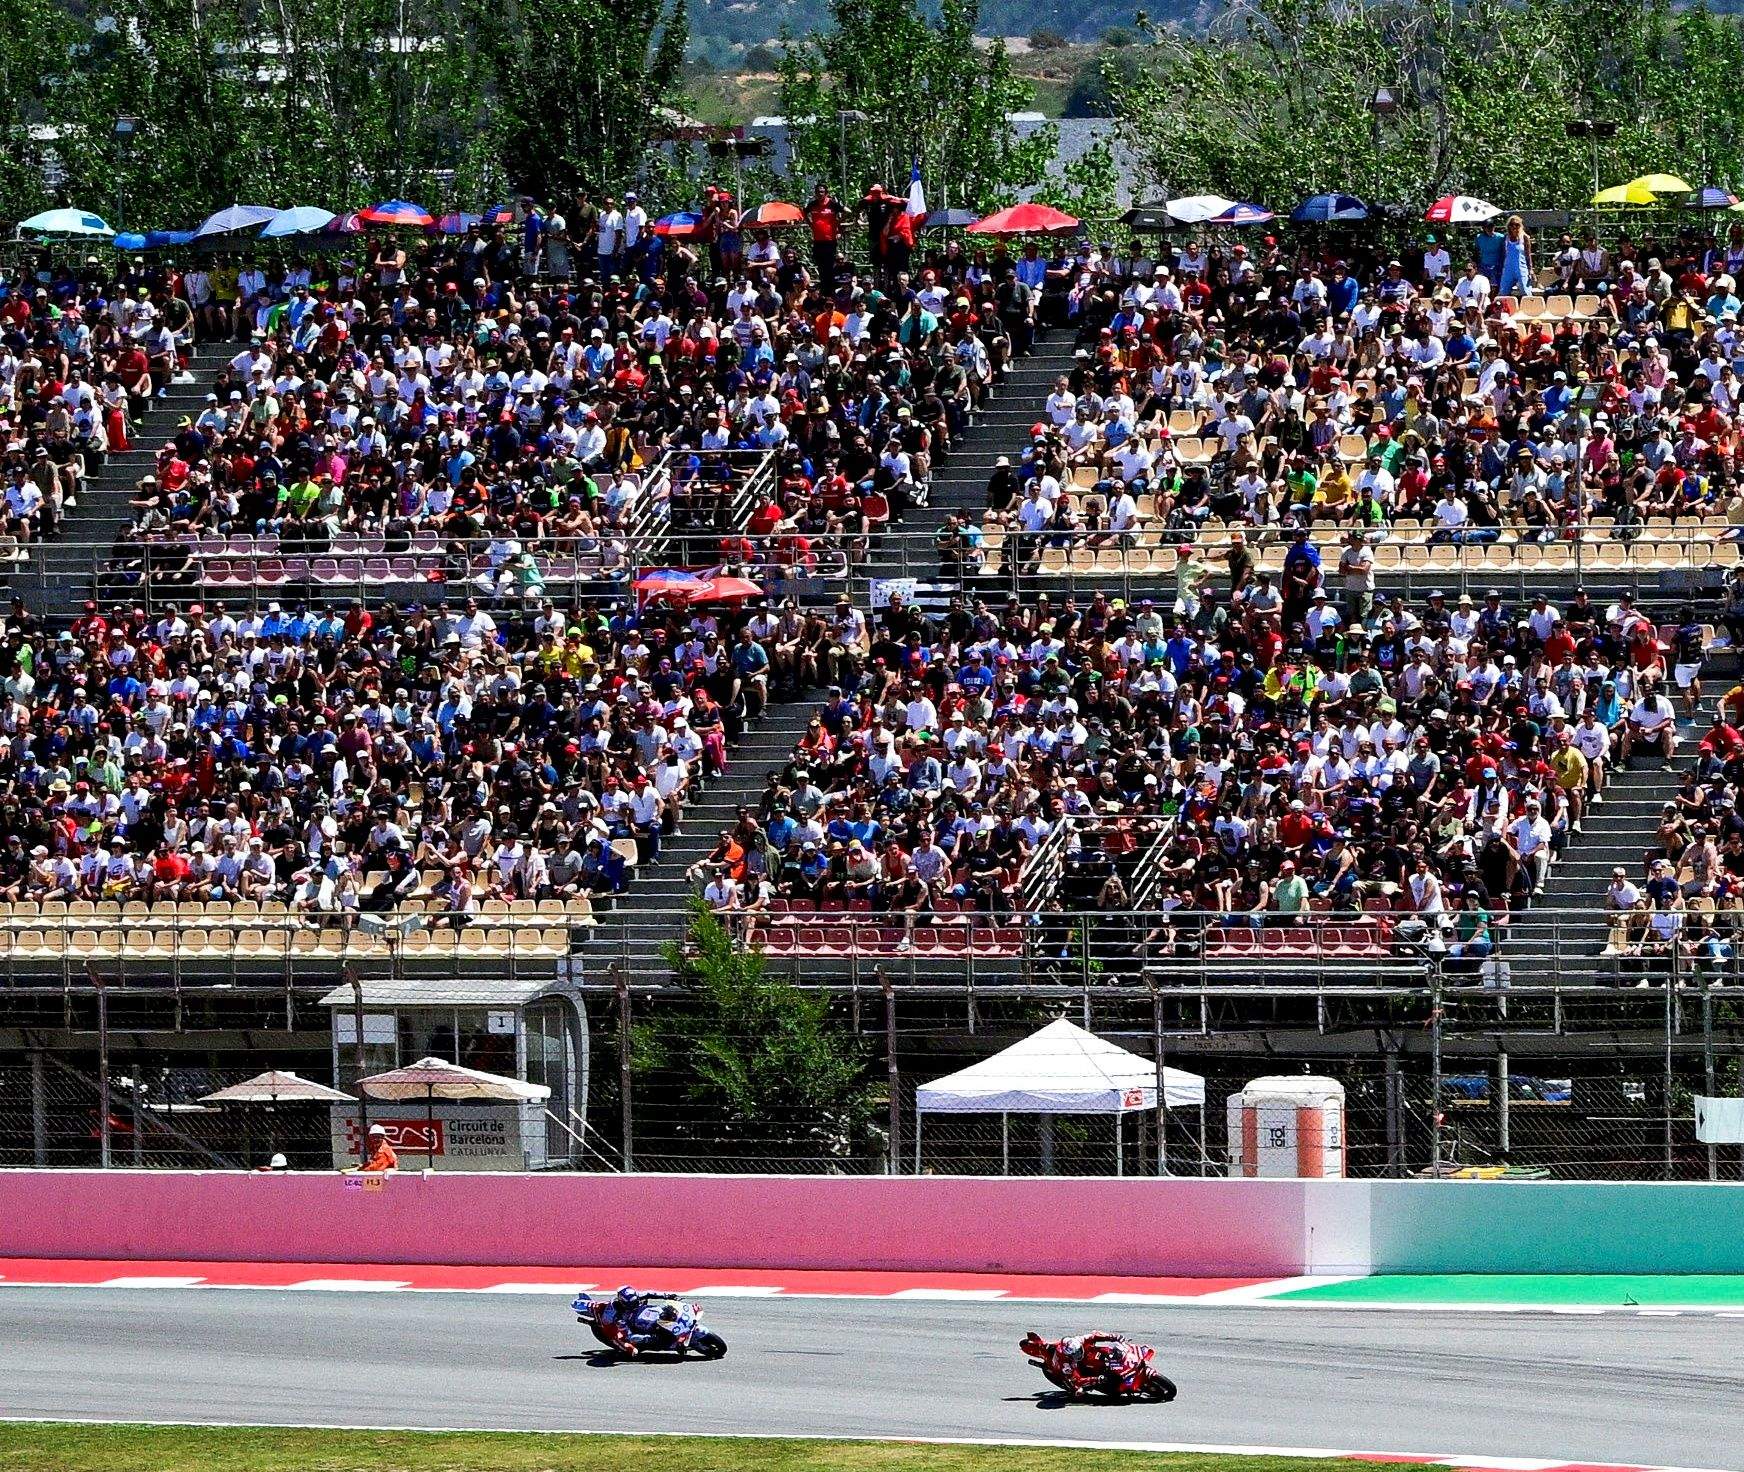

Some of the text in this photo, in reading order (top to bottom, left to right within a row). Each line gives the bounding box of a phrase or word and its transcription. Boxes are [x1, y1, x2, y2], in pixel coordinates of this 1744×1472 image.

[498, 1016, 505, 1028] 1
[449, 1120, 504, 1132] Circuit de
[450, 1134, 506, 1145] Barcelona
